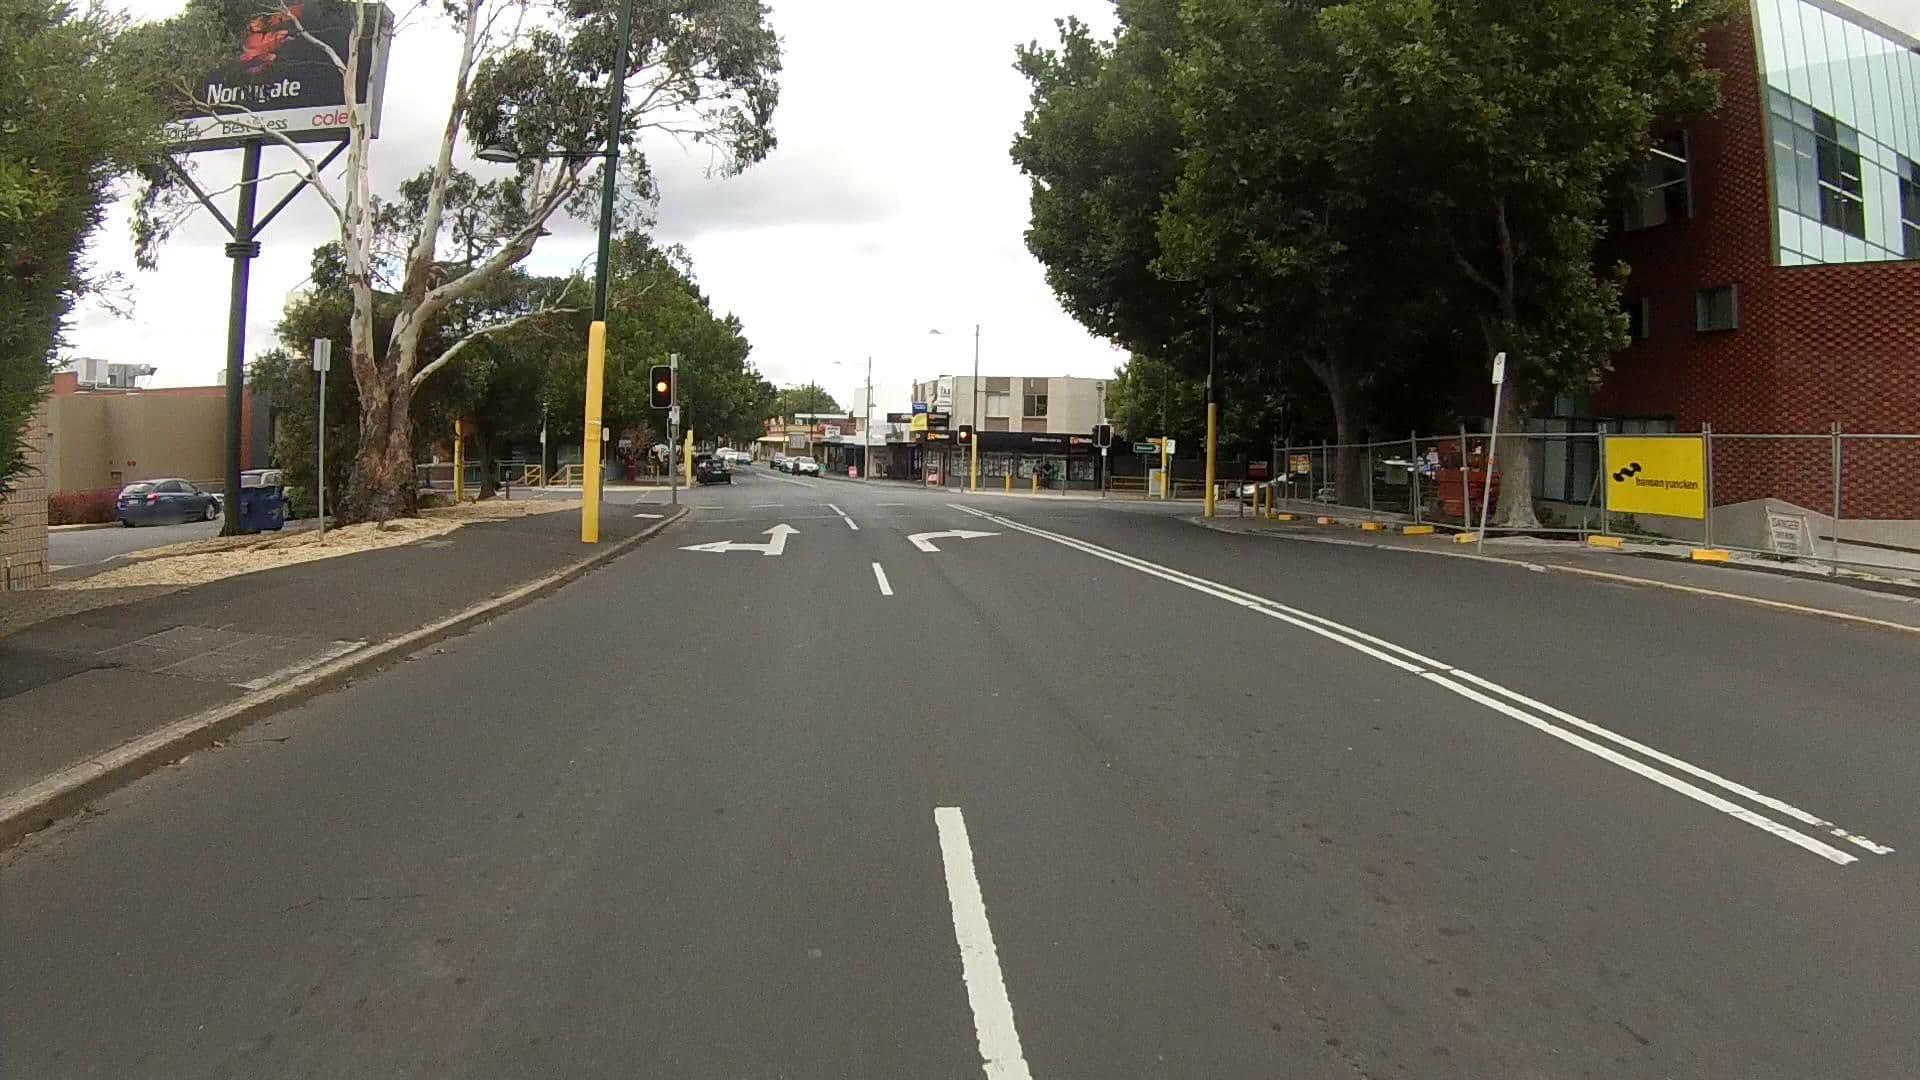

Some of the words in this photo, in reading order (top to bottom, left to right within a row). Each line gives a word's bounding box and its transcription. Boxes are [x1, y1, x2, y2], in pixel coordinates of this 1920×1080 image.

[207, 79, 301, 105] Norgate
[312, 111, 349, 127] cole
[1636, 477, 1664, 488] hansen
[1664, 480, 1698, 490] yuncken
